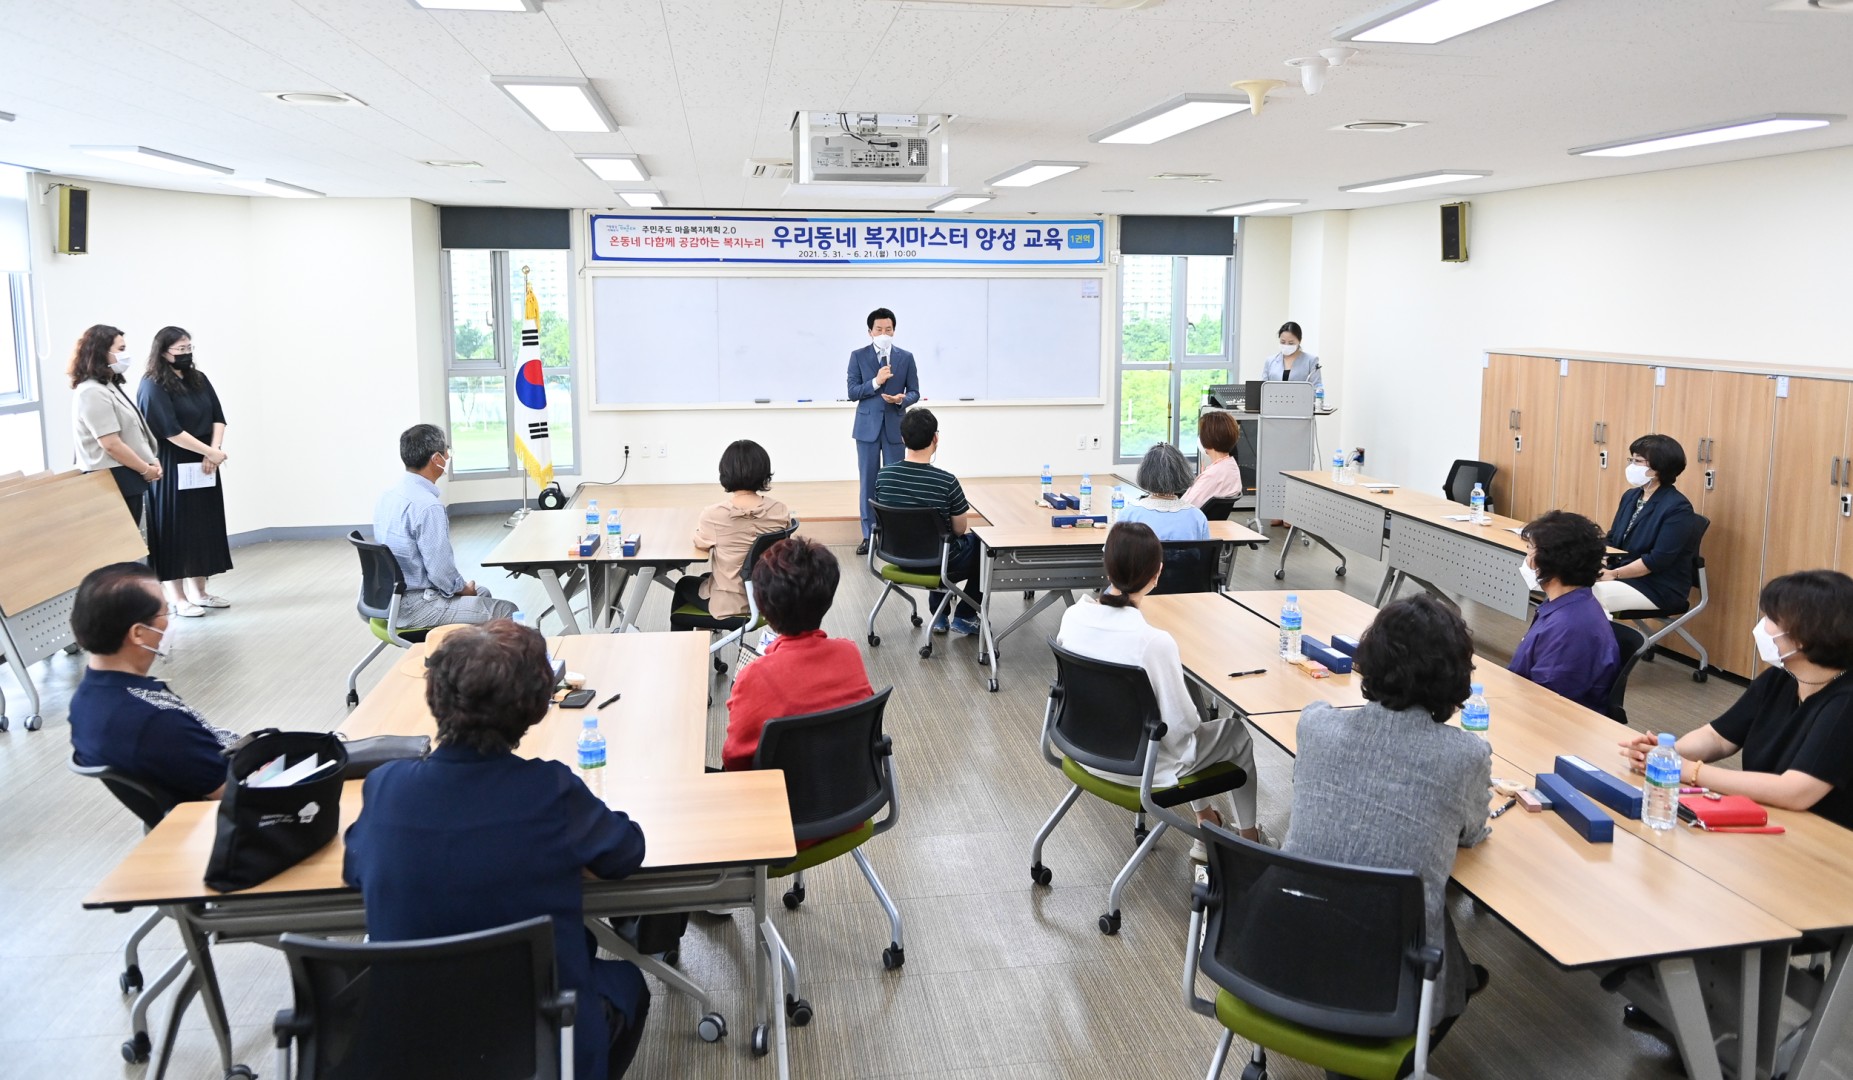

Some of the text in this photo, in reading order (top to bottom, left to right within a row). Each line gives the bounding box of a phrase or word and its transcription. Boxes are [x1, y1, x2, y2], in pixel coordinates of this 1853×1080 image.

[642, 225, 737, 235] 주민주도 마을복지계획 2.0
[609, 235, 764, 249] 온동네 다함께 공감하는 복지누리
[771, 225, 1064, 251] 우리동네 복지마스터 양성 교육
[1070, 233, 1091, 244] 1권역
[798, 250, 820, 258] 2021.
[823, 250, 830, 258] 5.
[832, 250, 844, 258] 31.
[853, 250, 861, 258] 6.
[894, 250, 917, 258] 10:00
